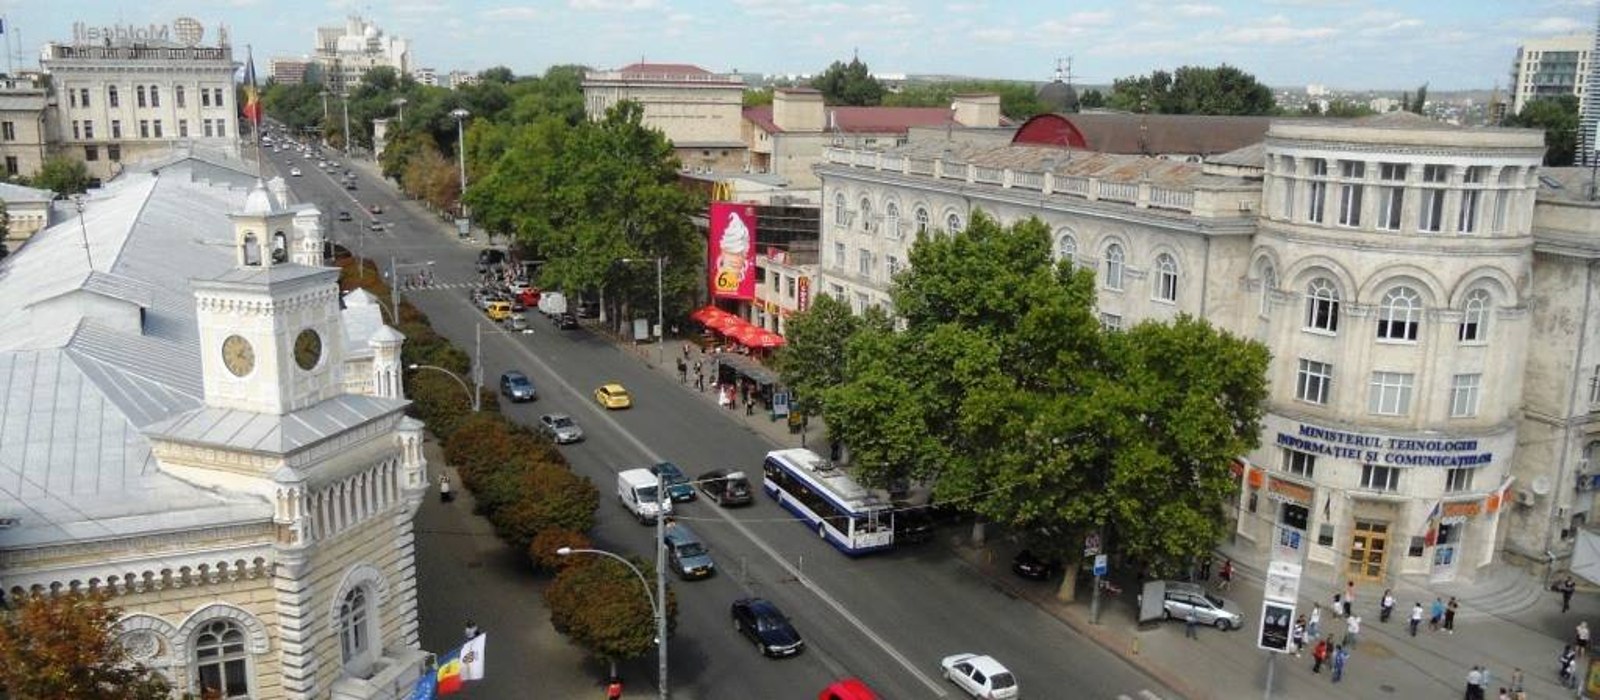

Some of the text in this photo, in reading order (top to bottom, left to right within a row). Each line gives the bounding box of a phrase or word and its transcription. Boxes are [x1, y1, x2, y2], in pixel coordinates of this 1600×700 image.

[1277, 432, 1361, 459] INFORMAȚIEI
[1385, 453, 1492, 467] COMUNICAȚIILOR
[1299, 424, 1477, 452] MINISTERUL TEHNOLOGIEI
